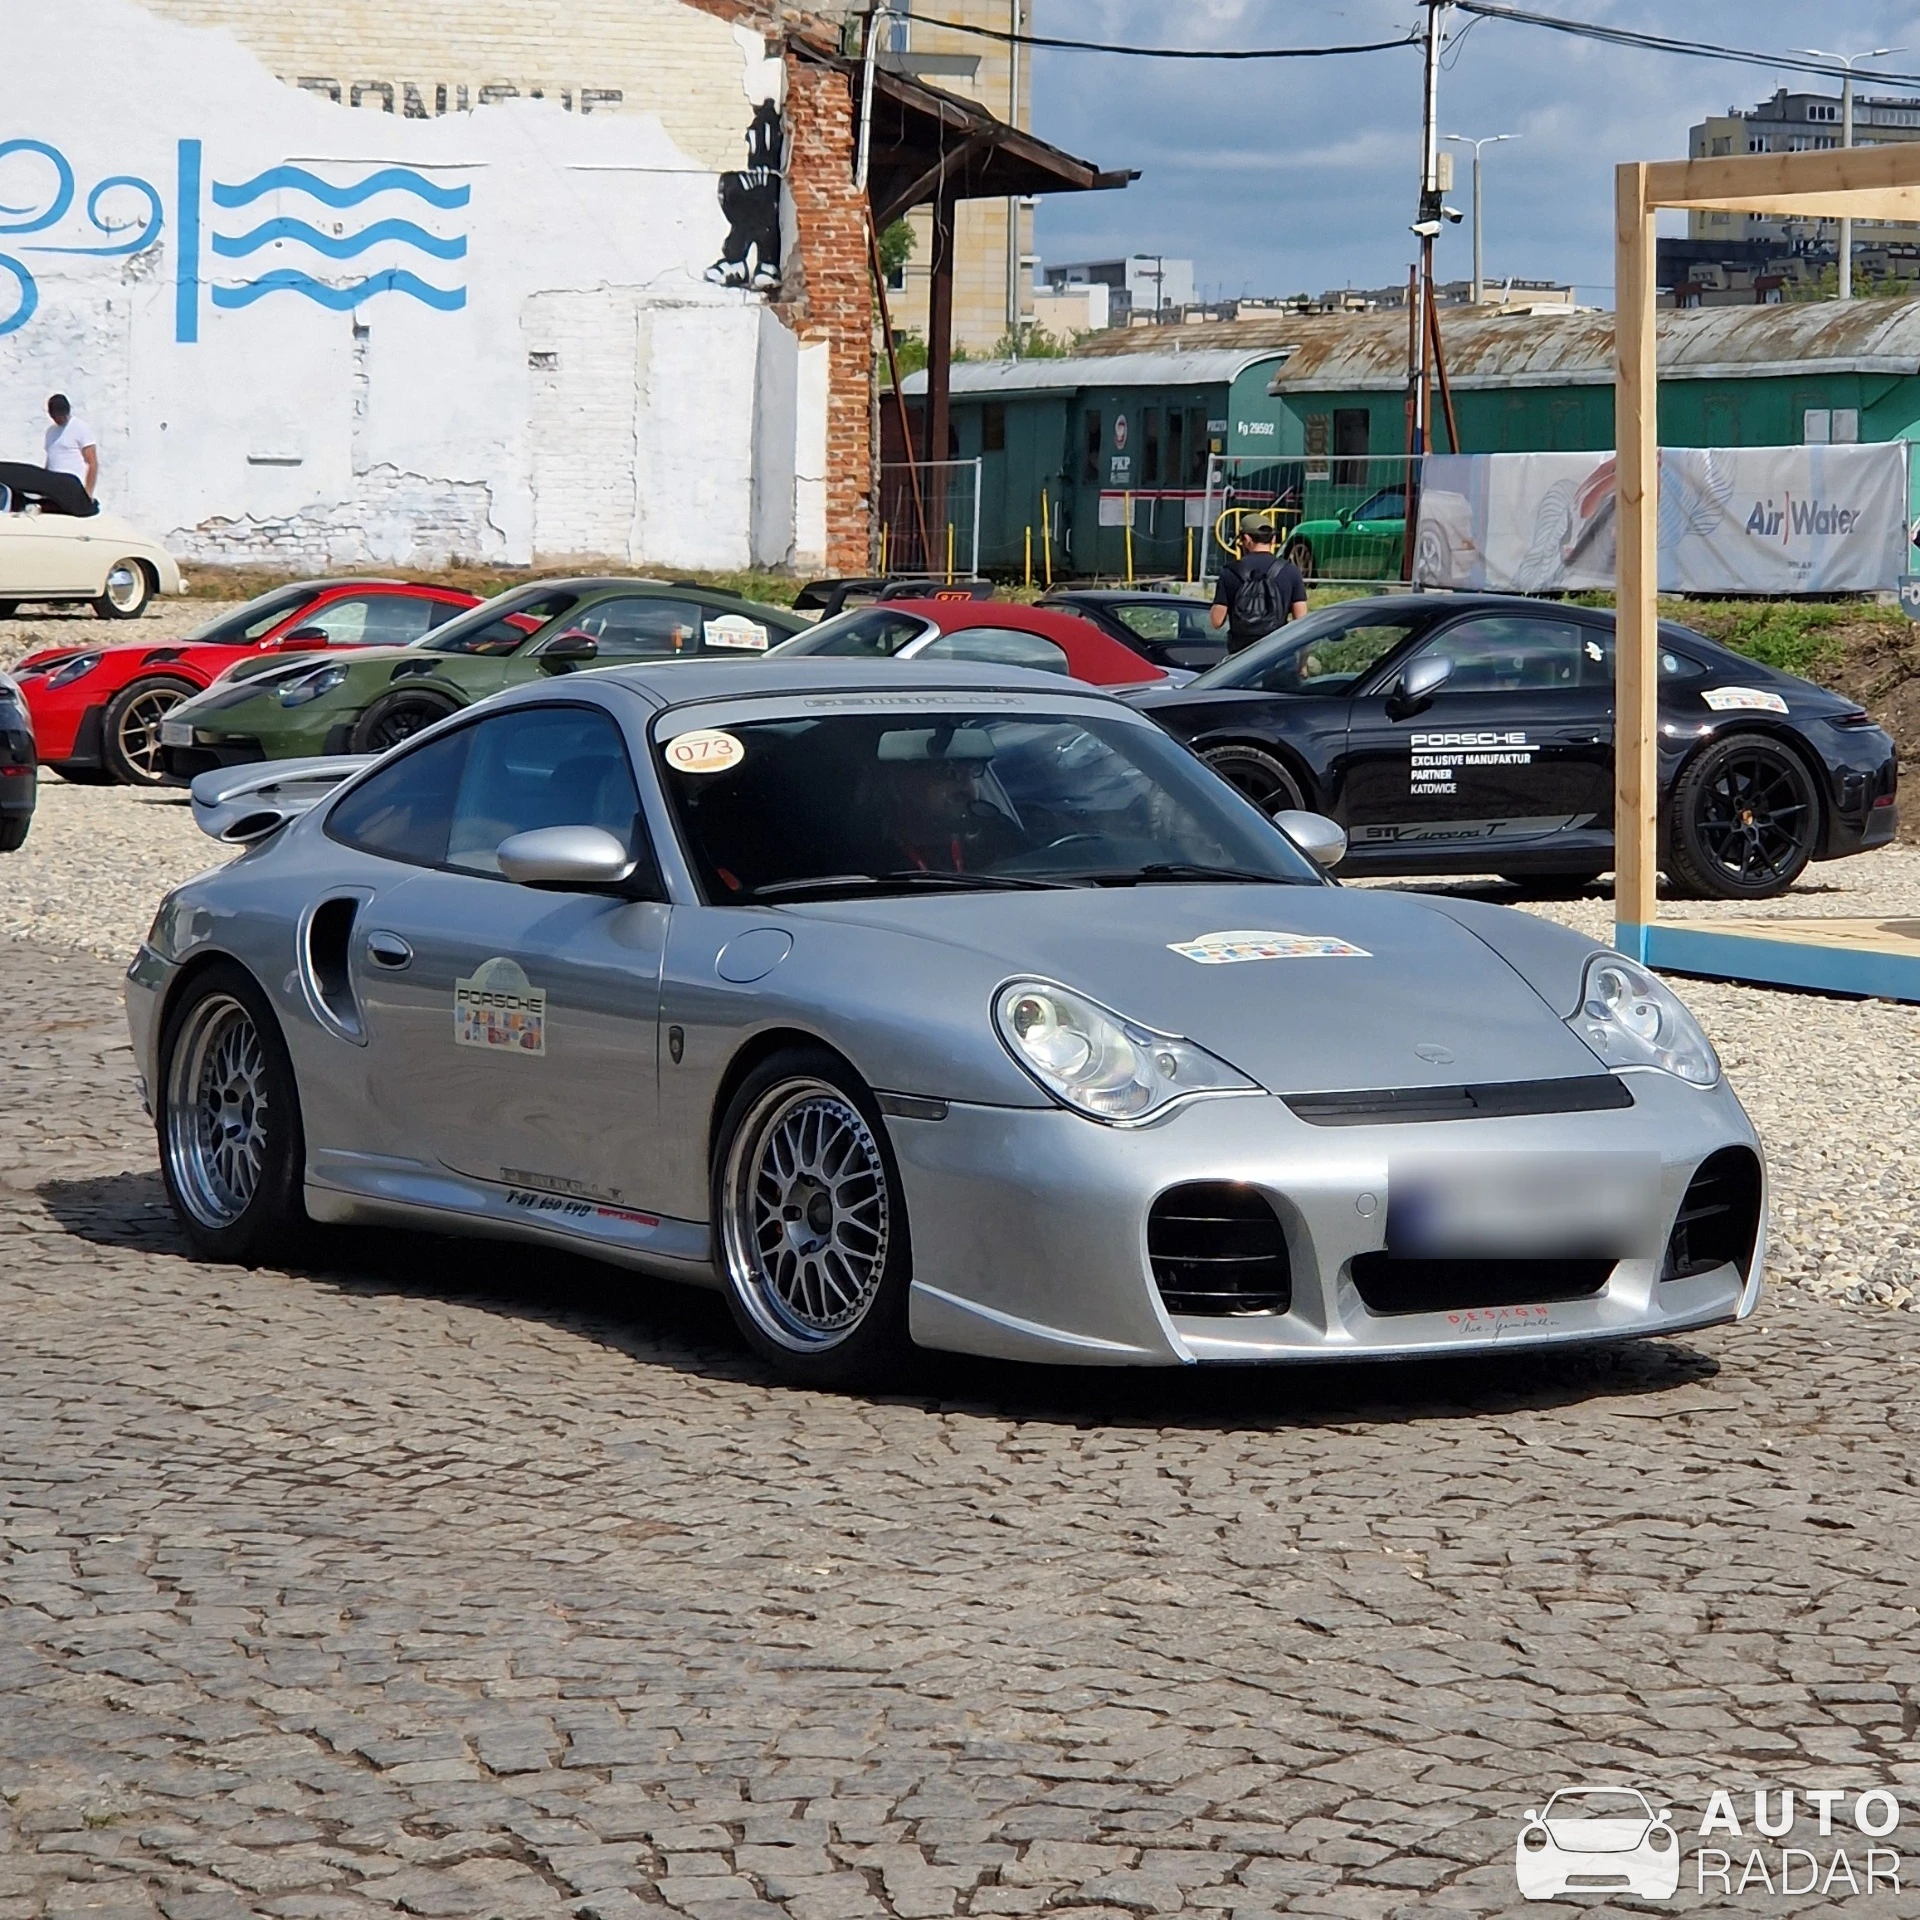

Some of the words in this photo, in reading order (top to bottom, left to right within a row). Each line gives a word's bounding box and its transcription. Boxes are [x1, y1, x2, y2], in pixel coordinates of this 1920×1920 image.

[1111, 456, 1131, 471] PKP
[1410, 732, 1527, 746] PORSCHE
[674, 739, 734, 762] 073
[1411, 755, 1464, 767] EXCLUSIVE
[1465, 754, 1532, 765] MANUFAKTUR
[1411, 769, 1453, 781] PARTNER
[1410, 783, 1457, 795] KATOWICE
[457, 989, 543, 1013] PORSCHE
[1447, 1306, 1549, 1325] DESIGN
